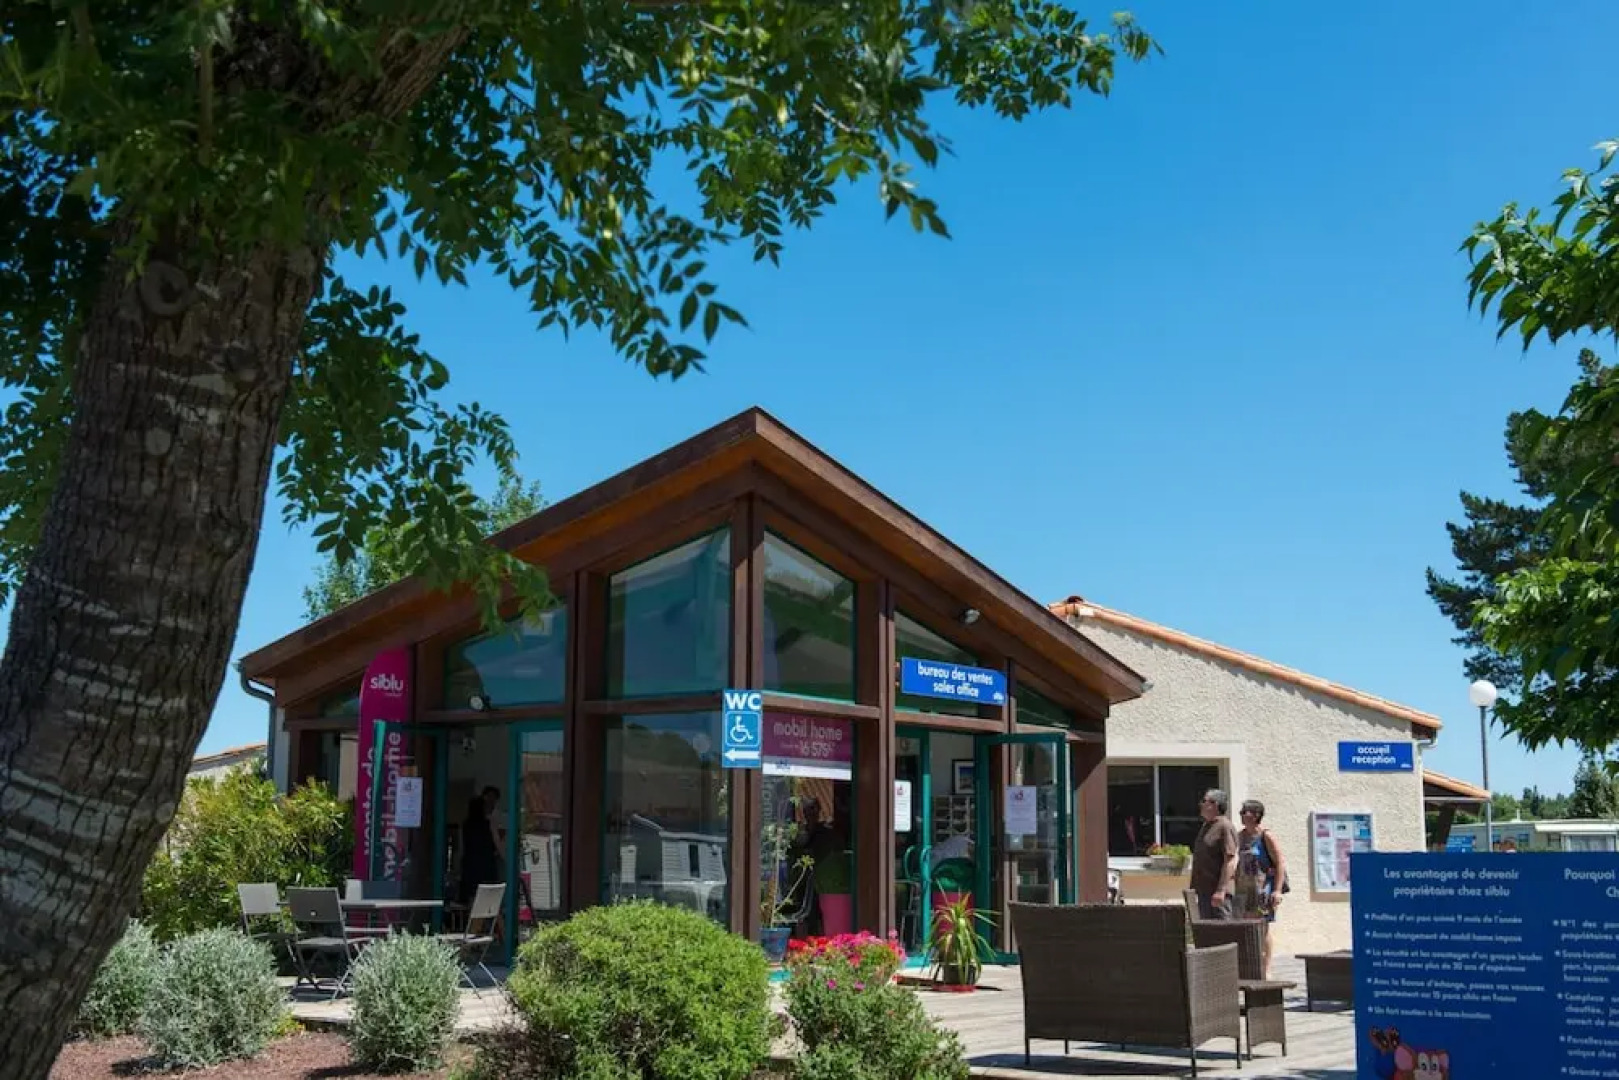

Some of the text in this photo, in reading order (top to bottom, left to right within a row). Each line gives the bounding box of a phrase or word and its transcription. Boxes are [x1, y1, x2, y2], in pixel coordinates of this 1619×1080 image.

[917, 660, 993, 686] bureau des ventes
[370, 673, 404, 691] siblu
[933, 680, 955, 694] sales
[956, 683, 979, 697] office
[725, 693, 761, 710] WC
[774, 716, 843, 742] mobil home
[1357, 745, 1390, 755] accueil
[1384, 868, 1519, 883] Les avantages de devenir
[1564, 867, 1616, 884] Pourquoi
[1394, 885, 1510, 899] propriétaire chez siblu
